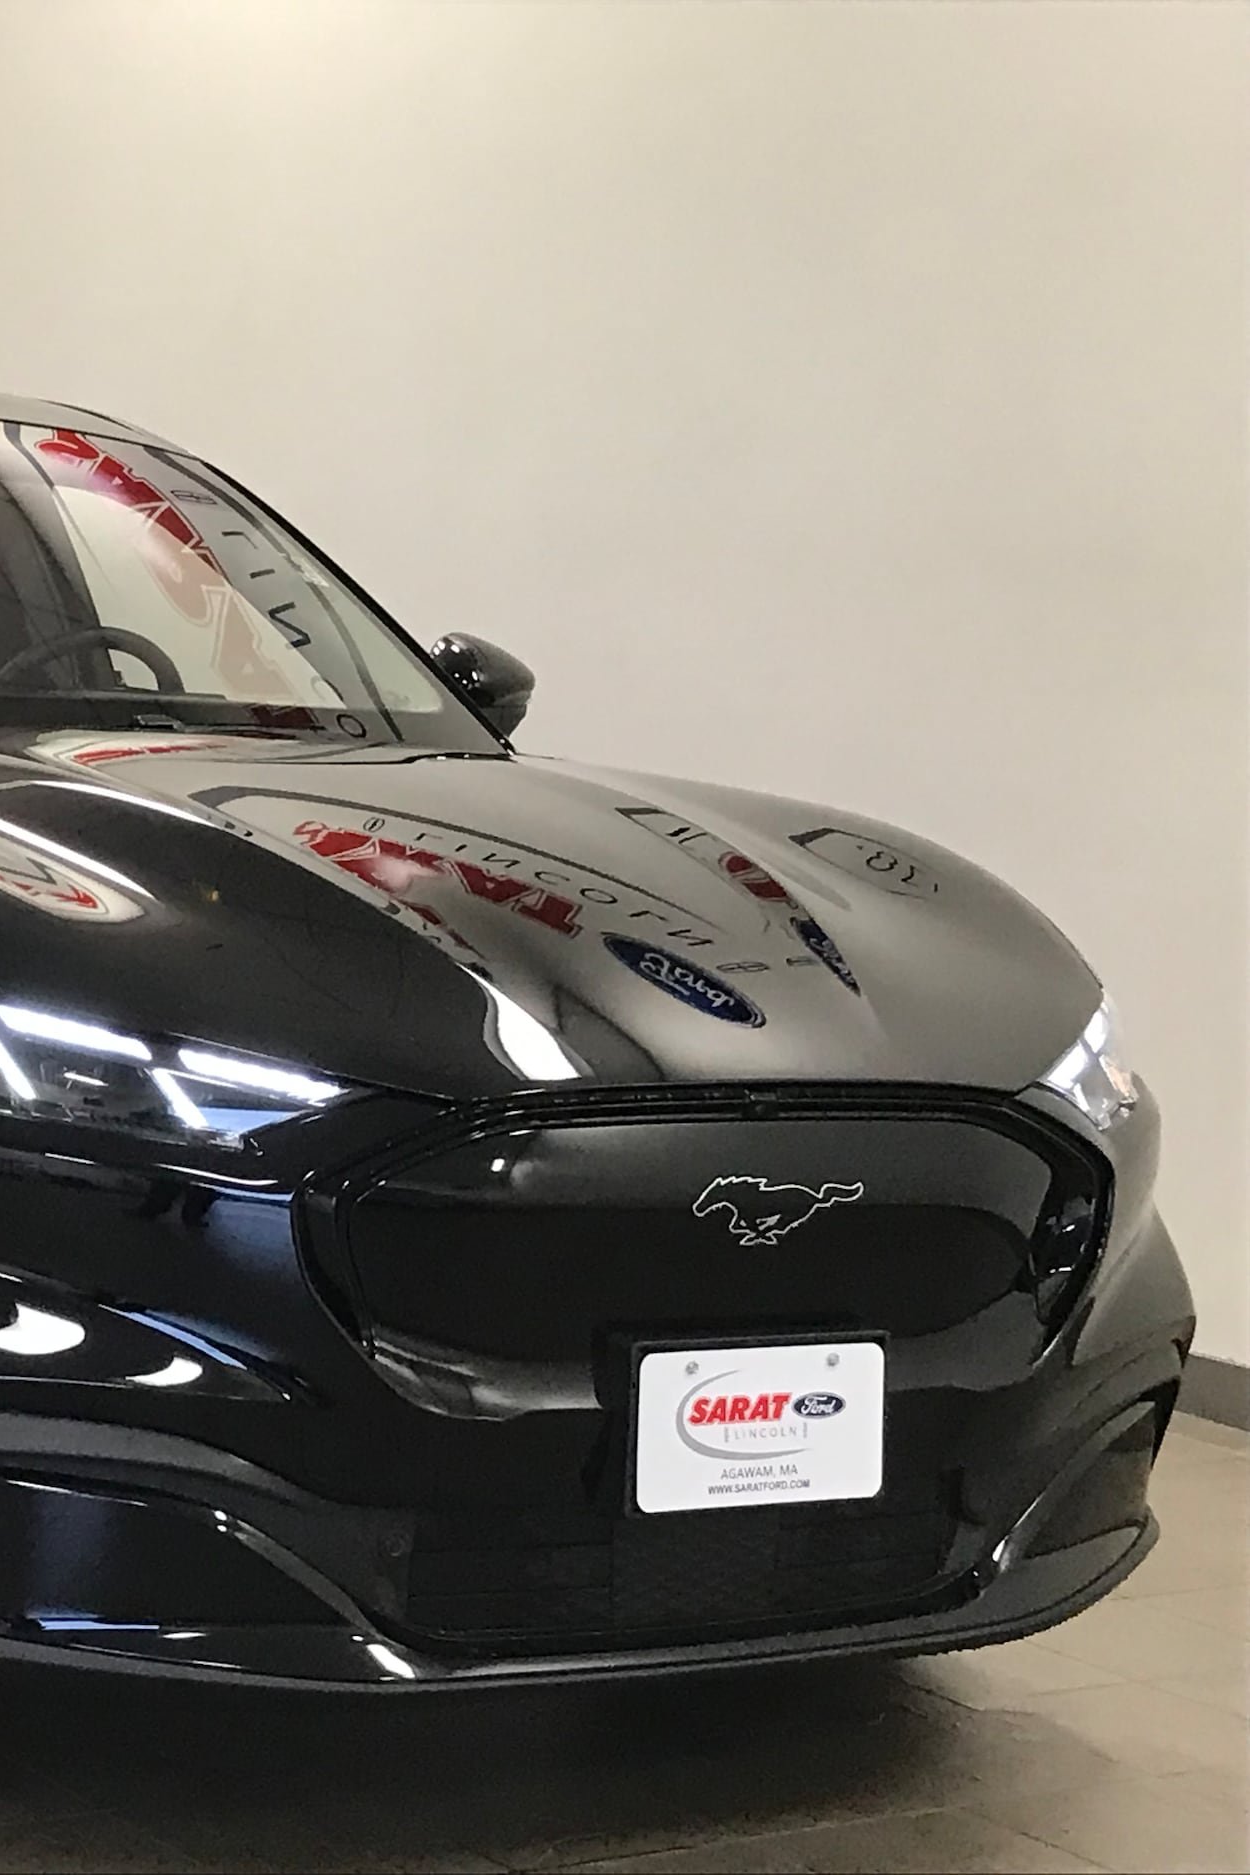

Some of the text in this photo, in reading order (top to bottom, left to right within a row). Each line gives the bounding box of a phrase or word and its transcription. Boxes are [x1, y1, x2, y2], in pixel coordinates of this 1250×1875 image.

[688, 1392, 837, 1426] SARAT Ford
[734, 1426, 797, 1440] LINCOLN
[720, 1464, 798, 1480] AGAWAM, MA
[707, 1479, 811, 1495] WWW.SARATFORD.COM
